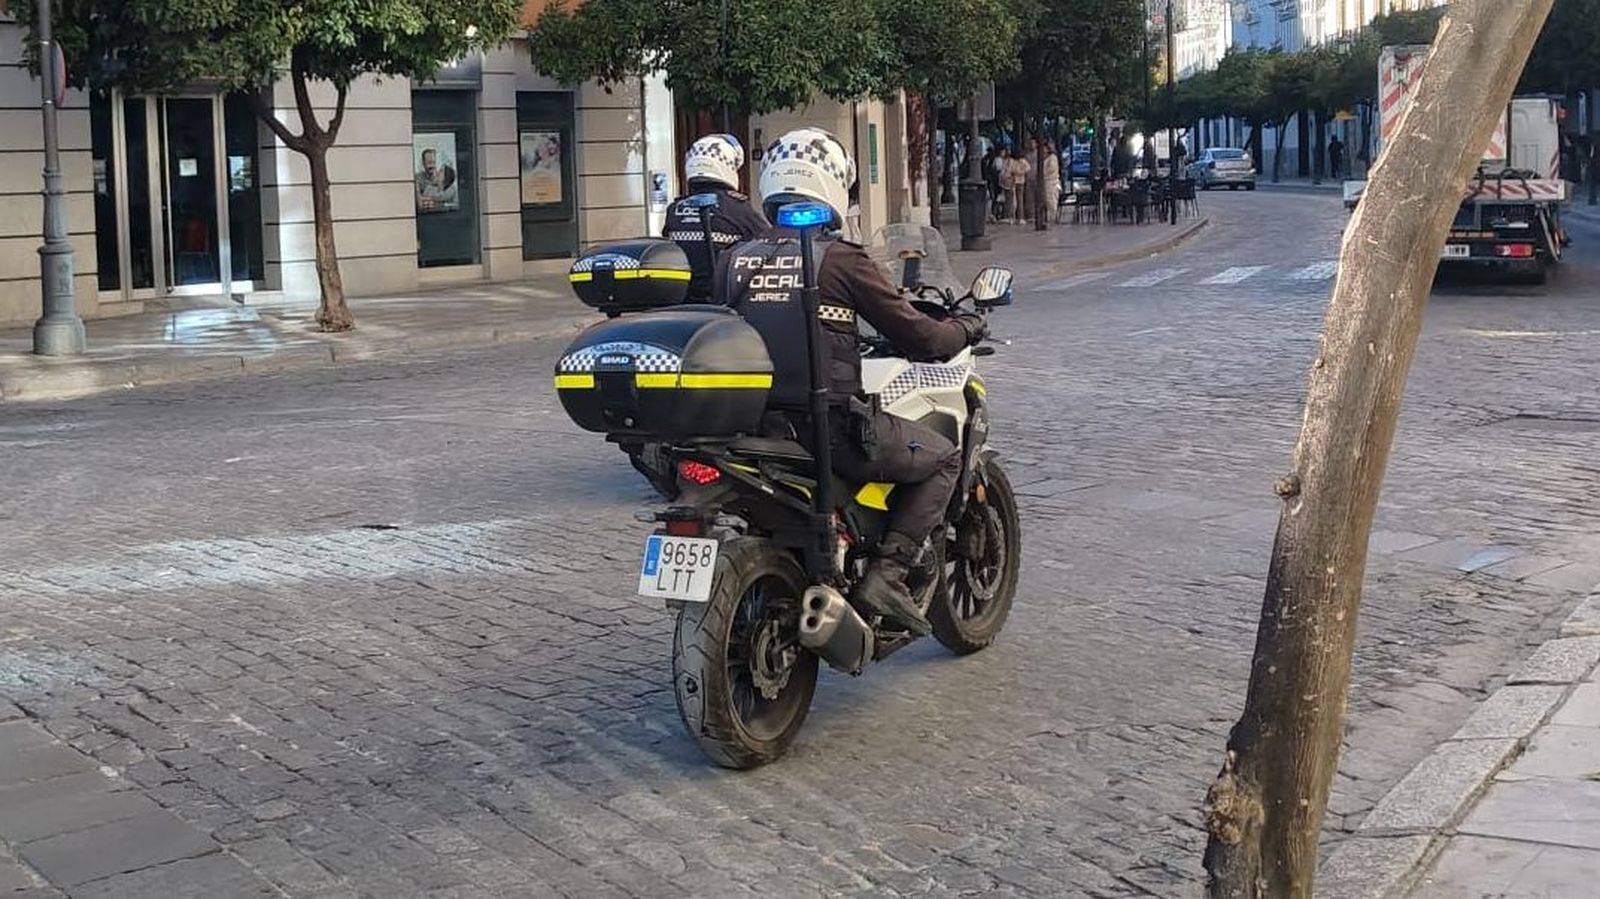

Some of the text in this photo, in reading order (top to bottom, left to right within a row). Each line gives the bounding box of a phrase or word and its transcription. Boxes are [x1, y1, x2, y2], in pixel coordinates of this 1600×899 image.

[734, 256, 803, 269] POLICI
[737, 274, 804, 288] OCAL
[749, 292, 790, 302] JEREZ
[601, 356, 629, 364] SHAD
[661, 541, 712, 568] 9658
[656, 567, 696, 593] LTT
